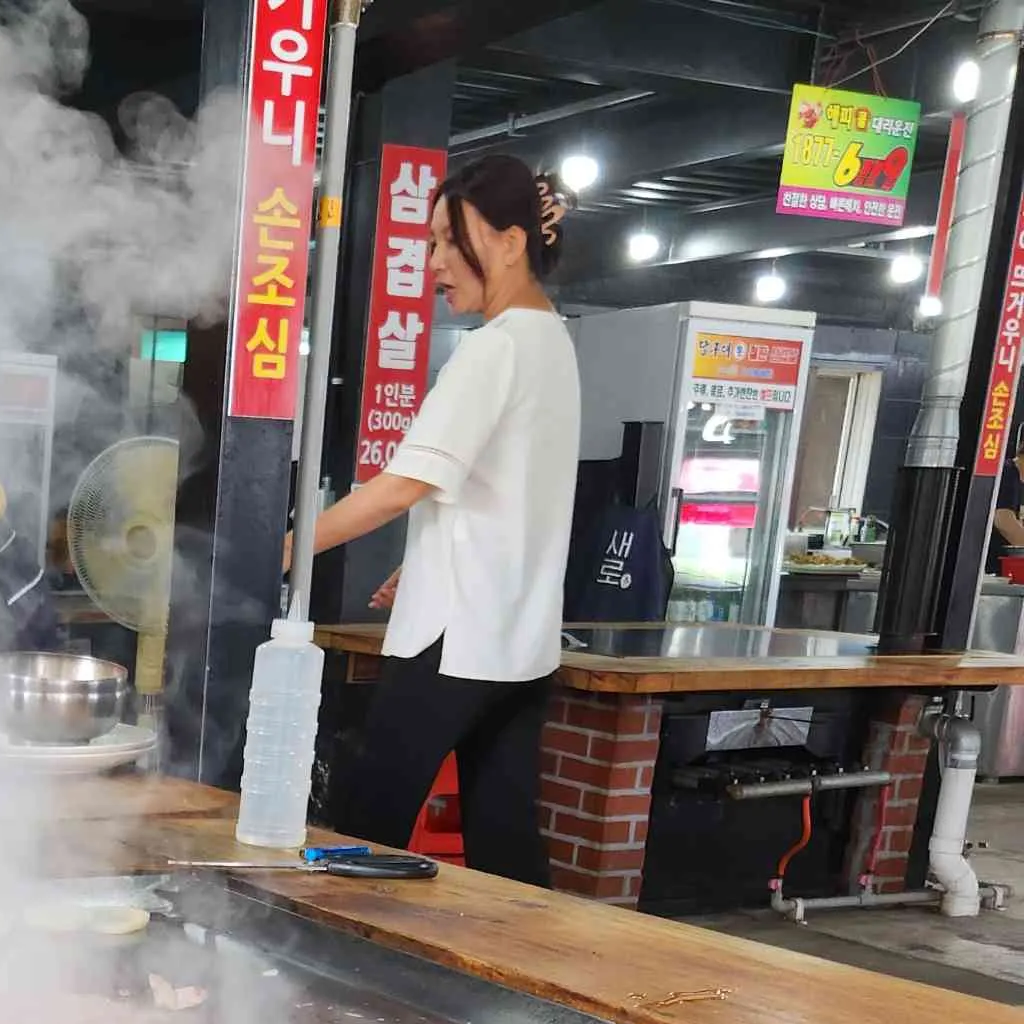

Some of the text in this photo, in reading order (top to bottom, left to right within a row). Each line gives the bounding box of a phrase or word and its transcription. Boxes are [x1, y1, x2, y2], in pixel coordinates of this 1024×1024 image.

[245, 187, 301, 380] 손조심
[378, 162, 437, 370] 삼겹살
[375, 382, 416, 408] 1인분
[983, 380, 1010, 461] 손조심
